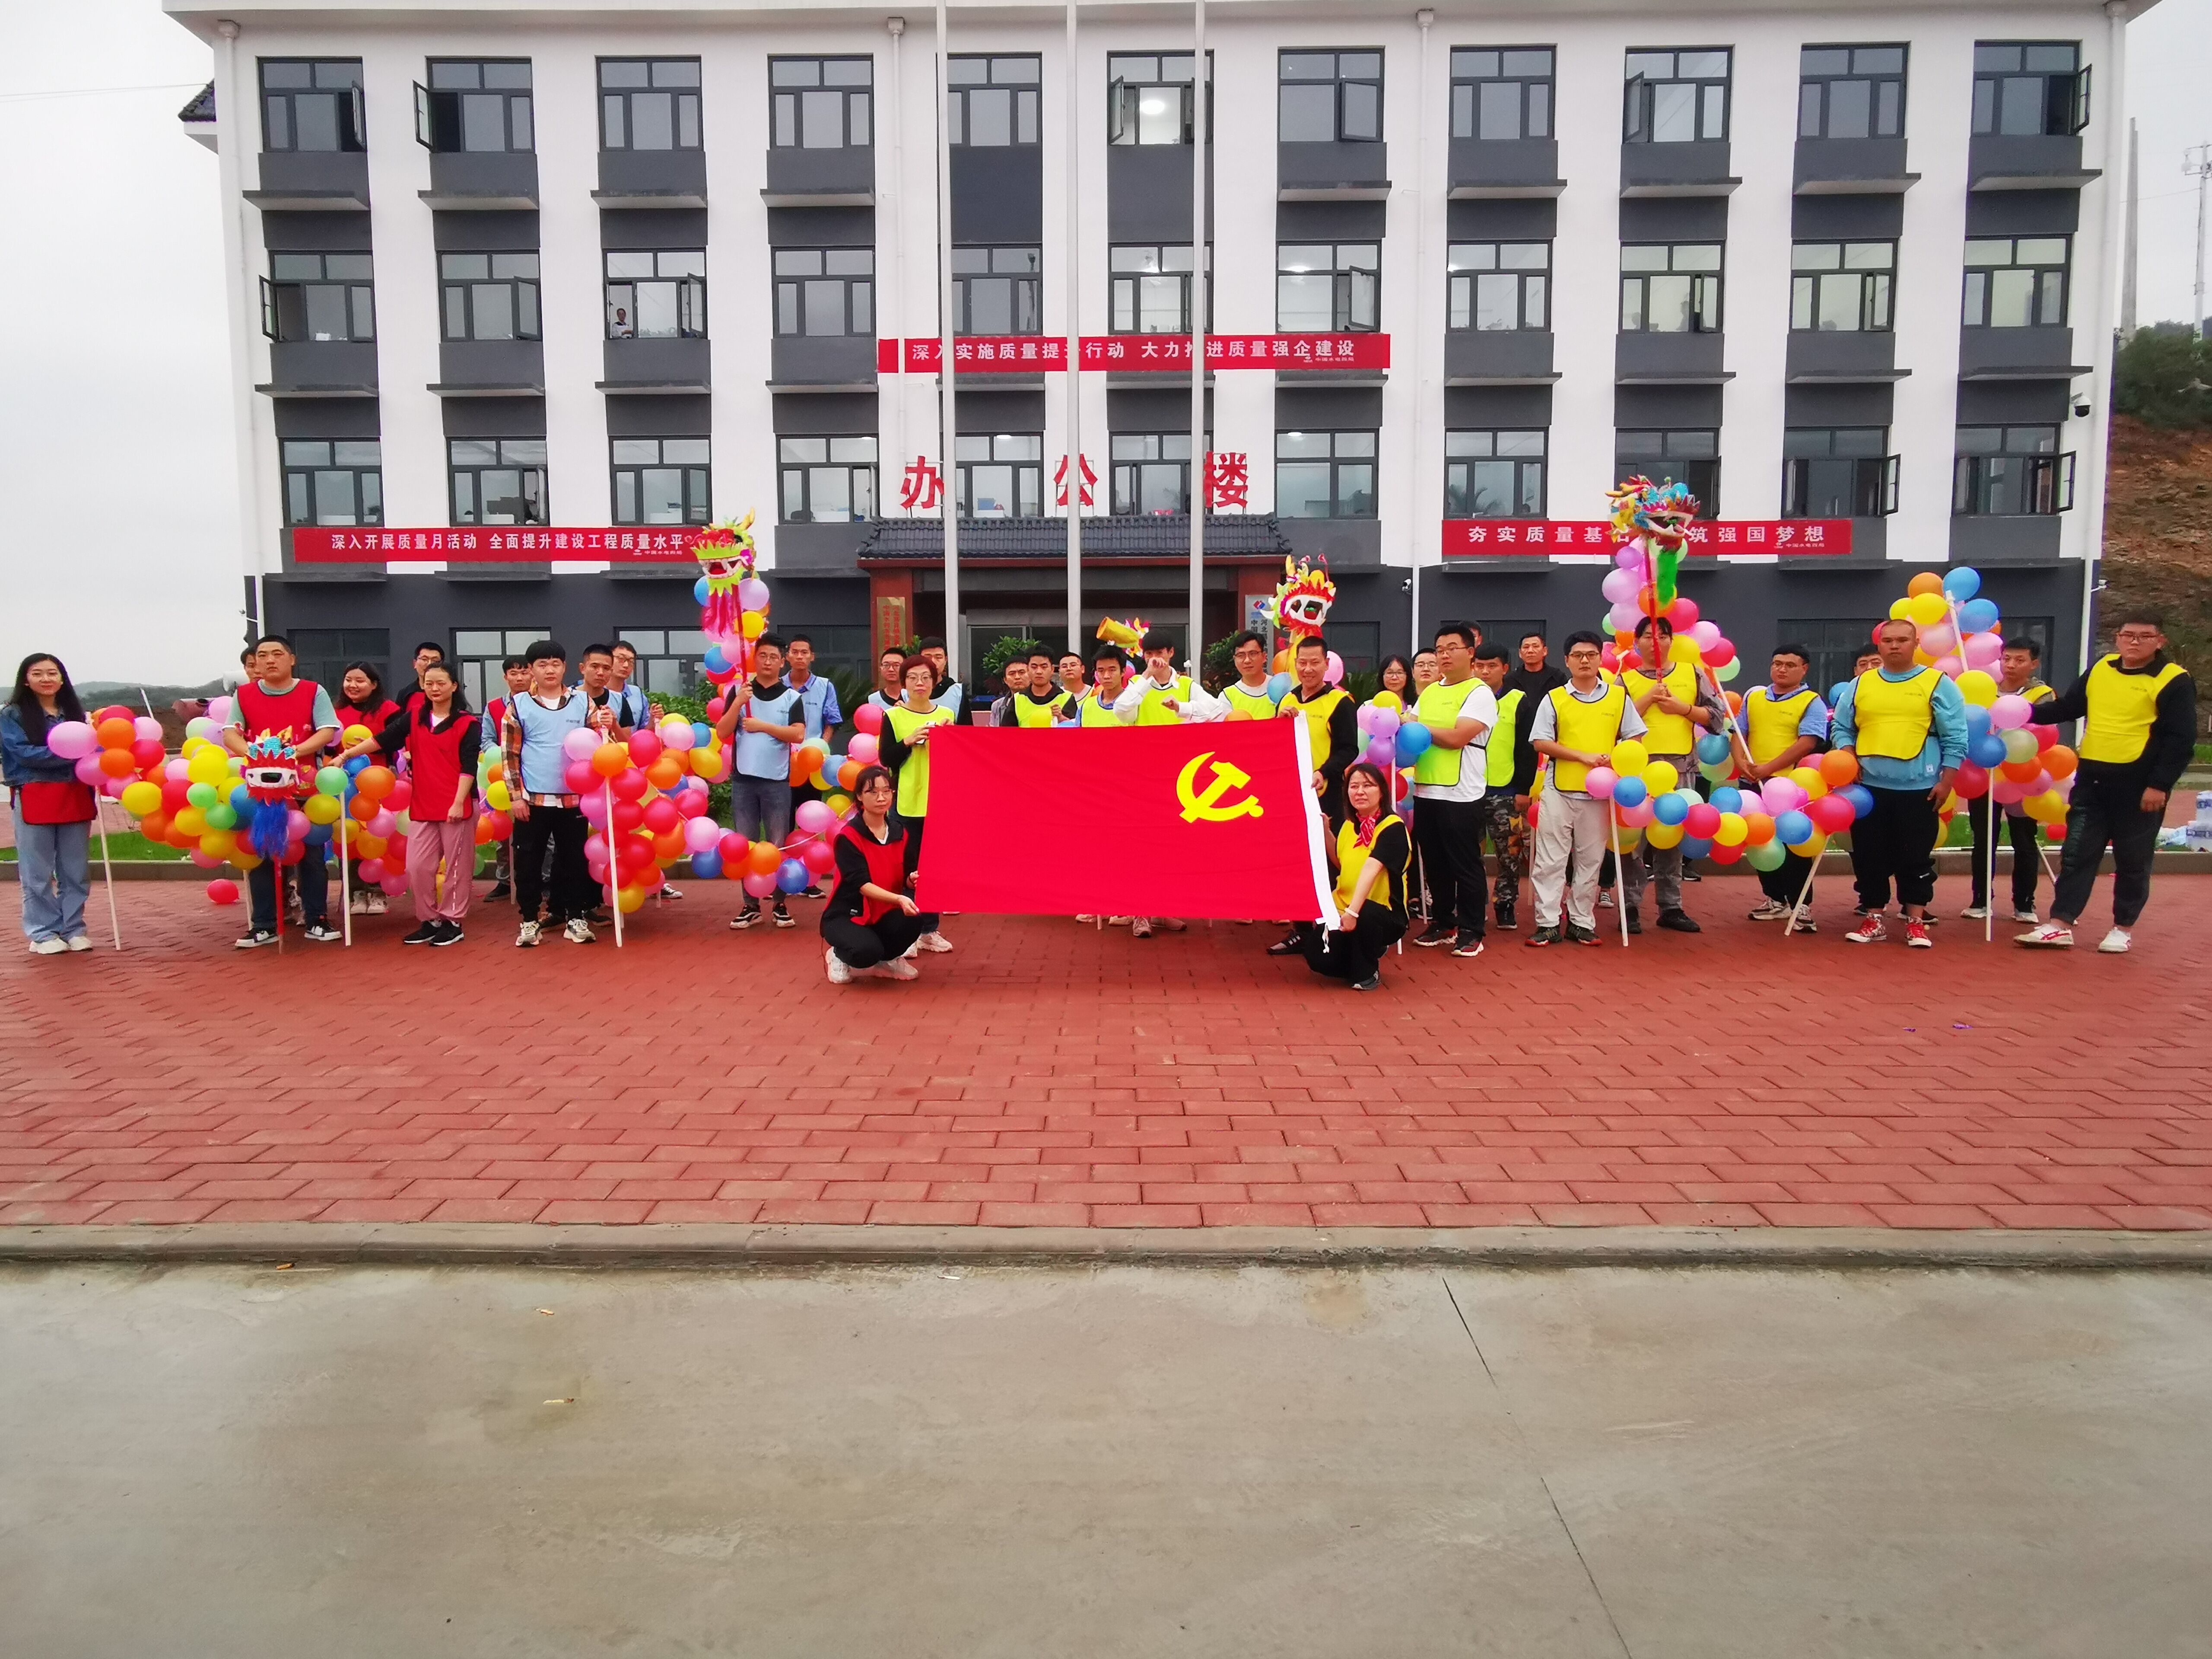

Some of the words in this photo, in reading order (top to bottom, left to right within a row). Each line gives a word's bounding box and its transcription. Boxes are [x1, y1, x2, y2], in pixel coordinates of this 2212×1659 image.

[912, 342, 1124, 360] 深入实施质量提行动
[901, 451, 1248, 509] 办公楼
[332, 533, 477, 550] 深入开展质量月活动
[489, 533, 684, 550] 全面提升建设工程质量水平
[1688, 526, 1824, 543] 筑强国梦想
